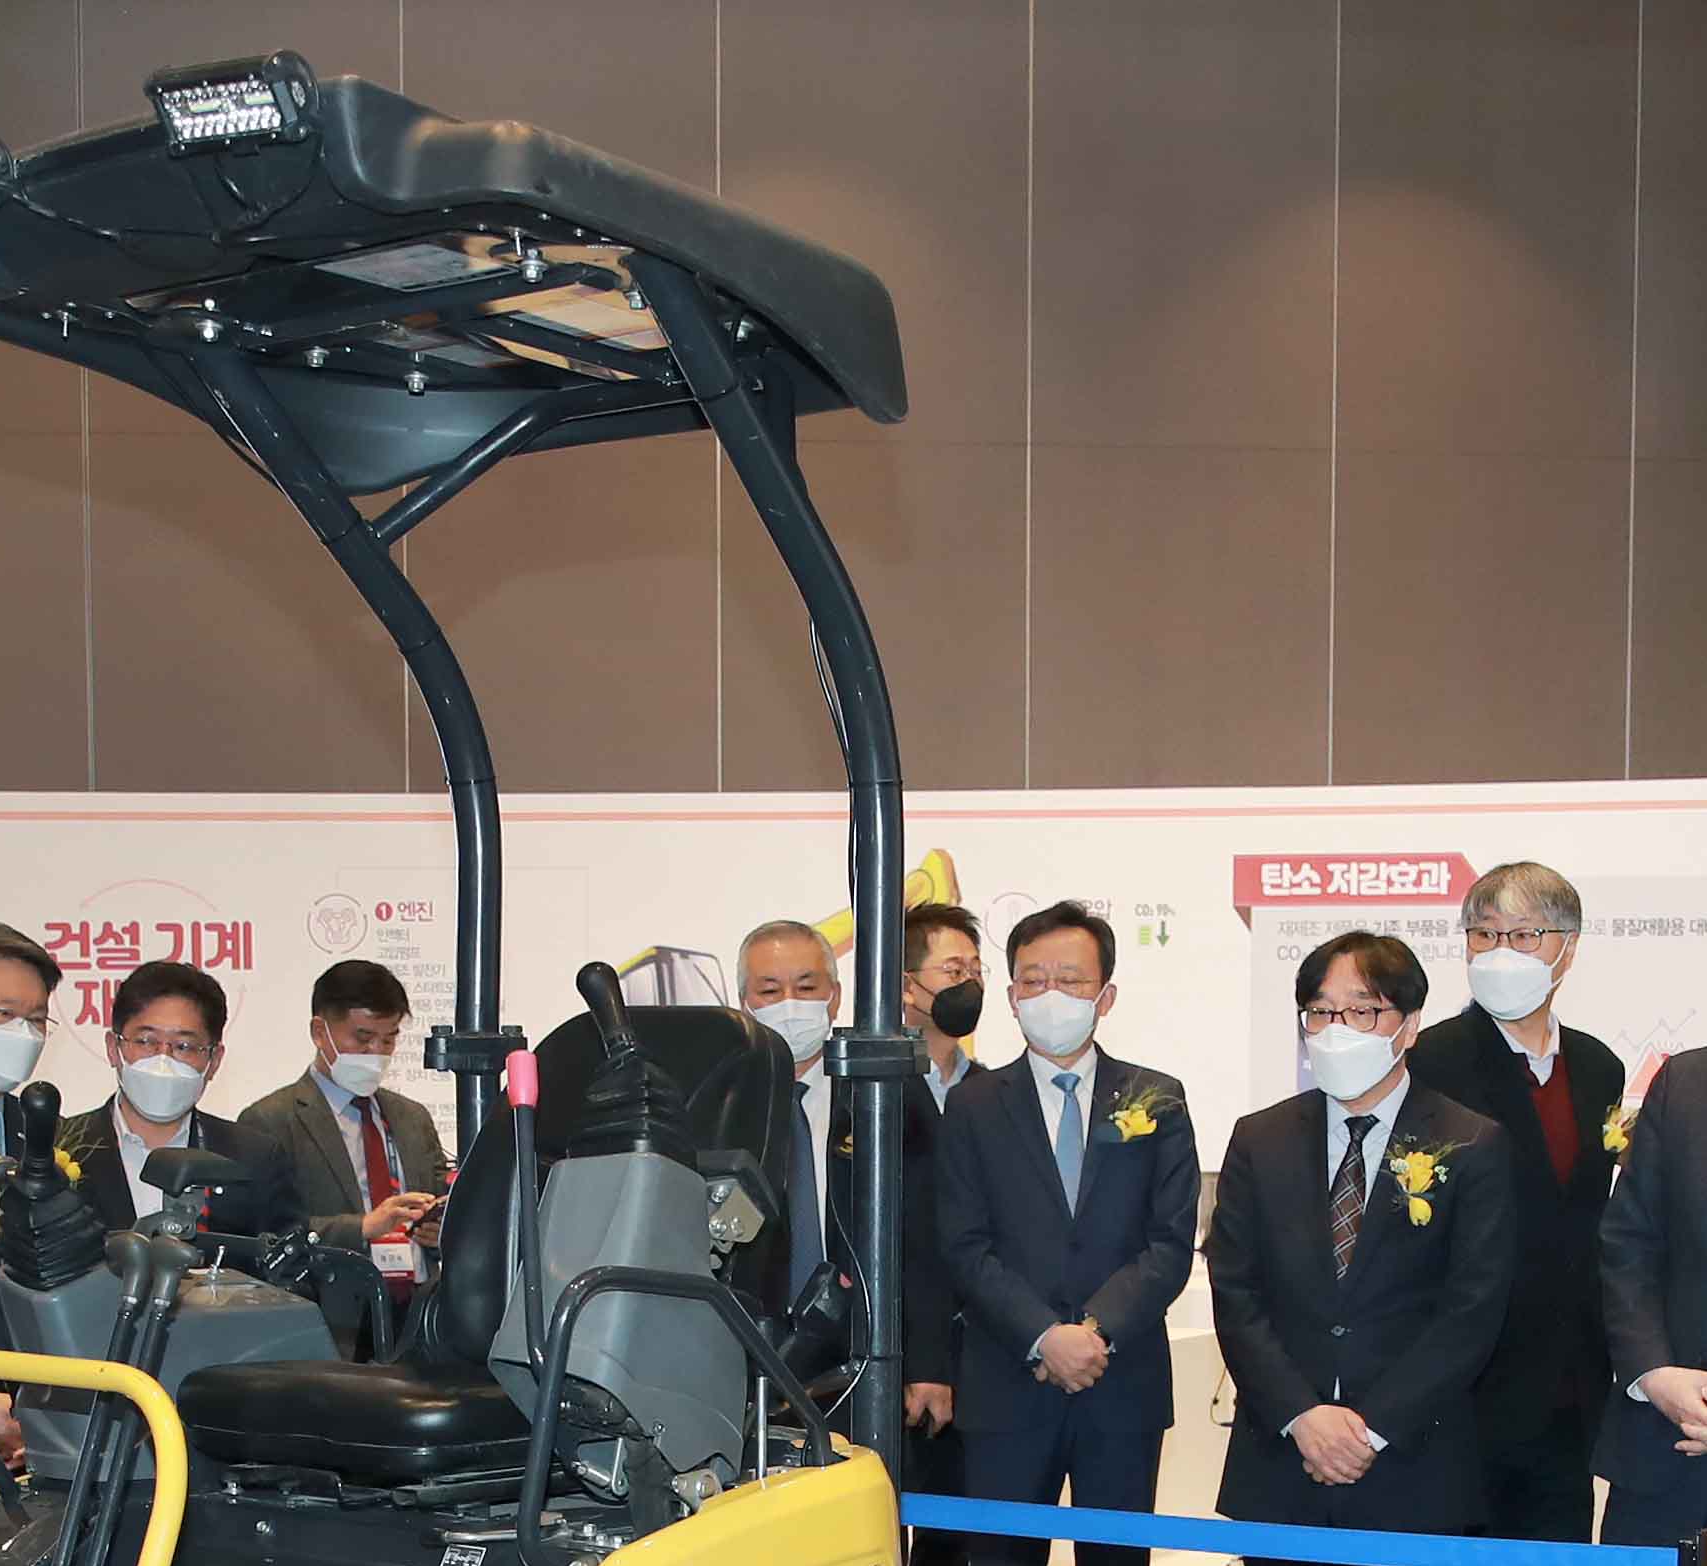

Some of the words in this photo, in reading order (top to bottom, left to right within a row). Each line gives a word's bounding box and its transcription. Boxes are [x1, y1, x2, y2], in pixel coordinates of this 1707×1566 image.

[1261, 861, 1322, 896] 탄소
[1326, 860, 1452, 896] 저감효과
[397, 900, 434, 922] 엔진
[44, 921, 143, 970] 건설
[155, 921, 254, 971] 기계
